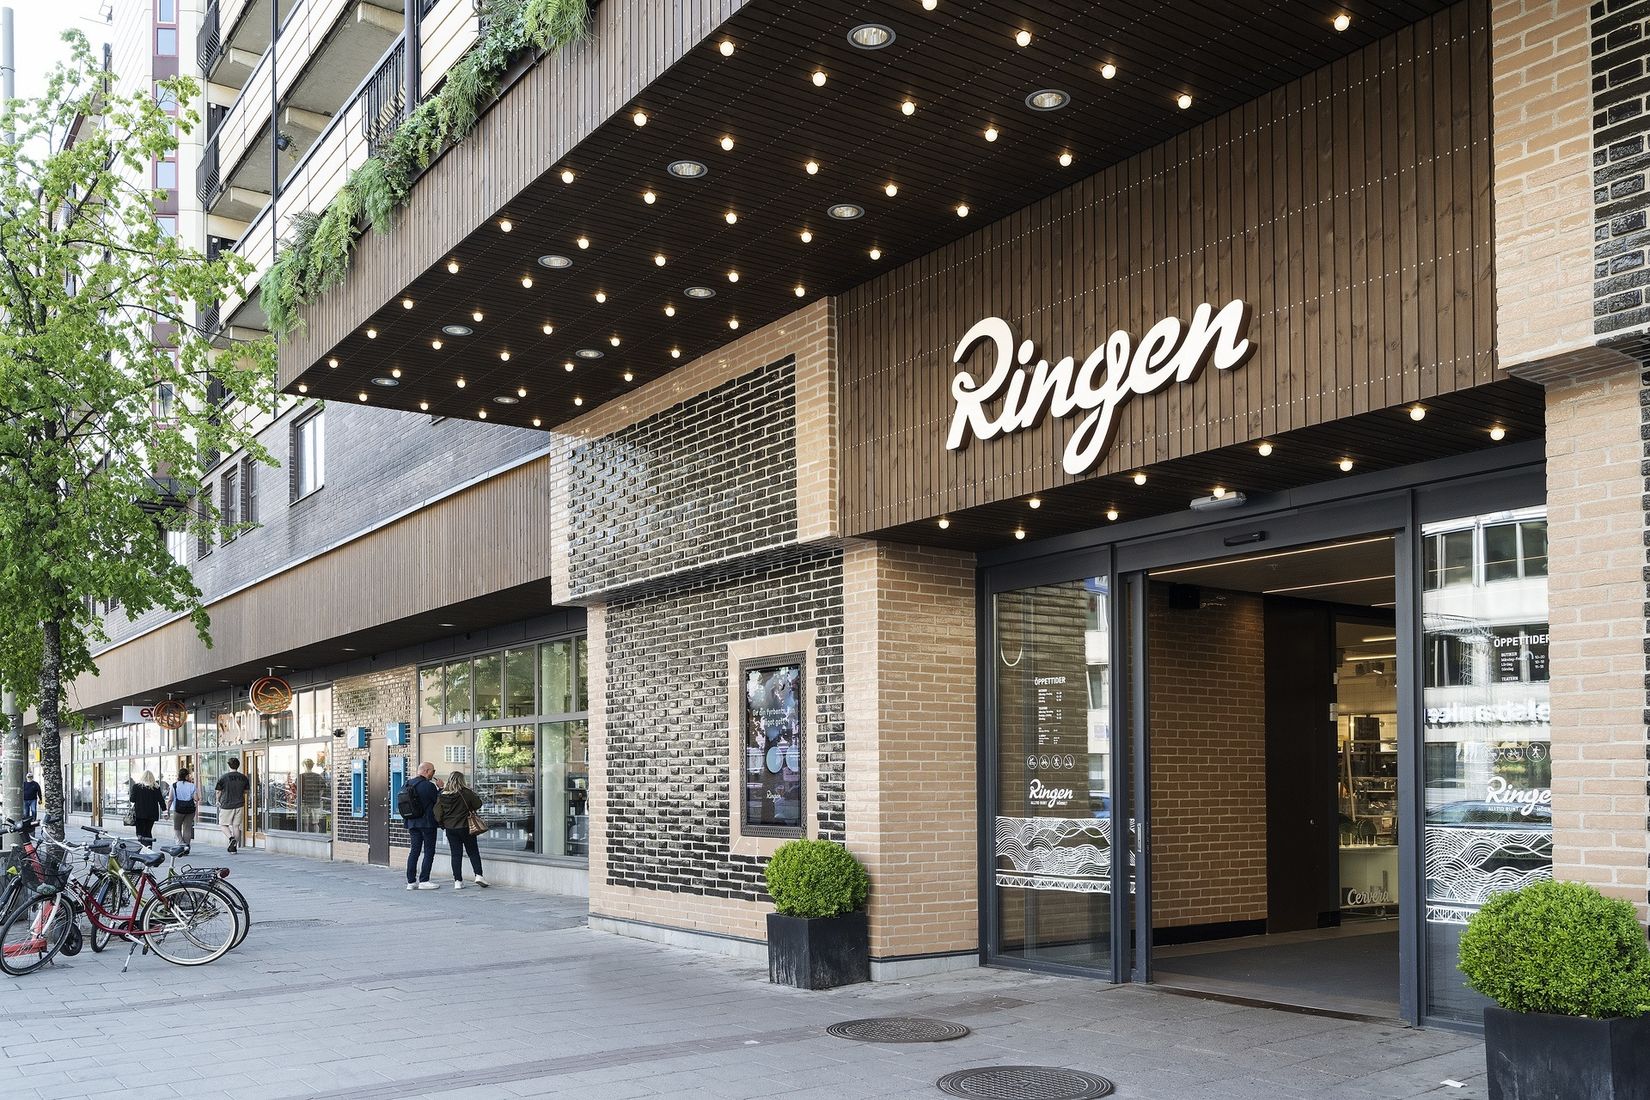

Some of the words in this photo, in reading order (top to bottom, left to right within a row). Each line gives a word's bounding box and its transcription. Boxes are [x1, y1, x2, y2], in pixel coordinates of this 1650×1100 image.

[946, 299, 1254, 475] Ringen
[1034, 676, 1066, 686] ÖPPETTIDER
[1029, 778, 1073, 808] Ringen
[1347, 888, 1389, 906] Cervera
